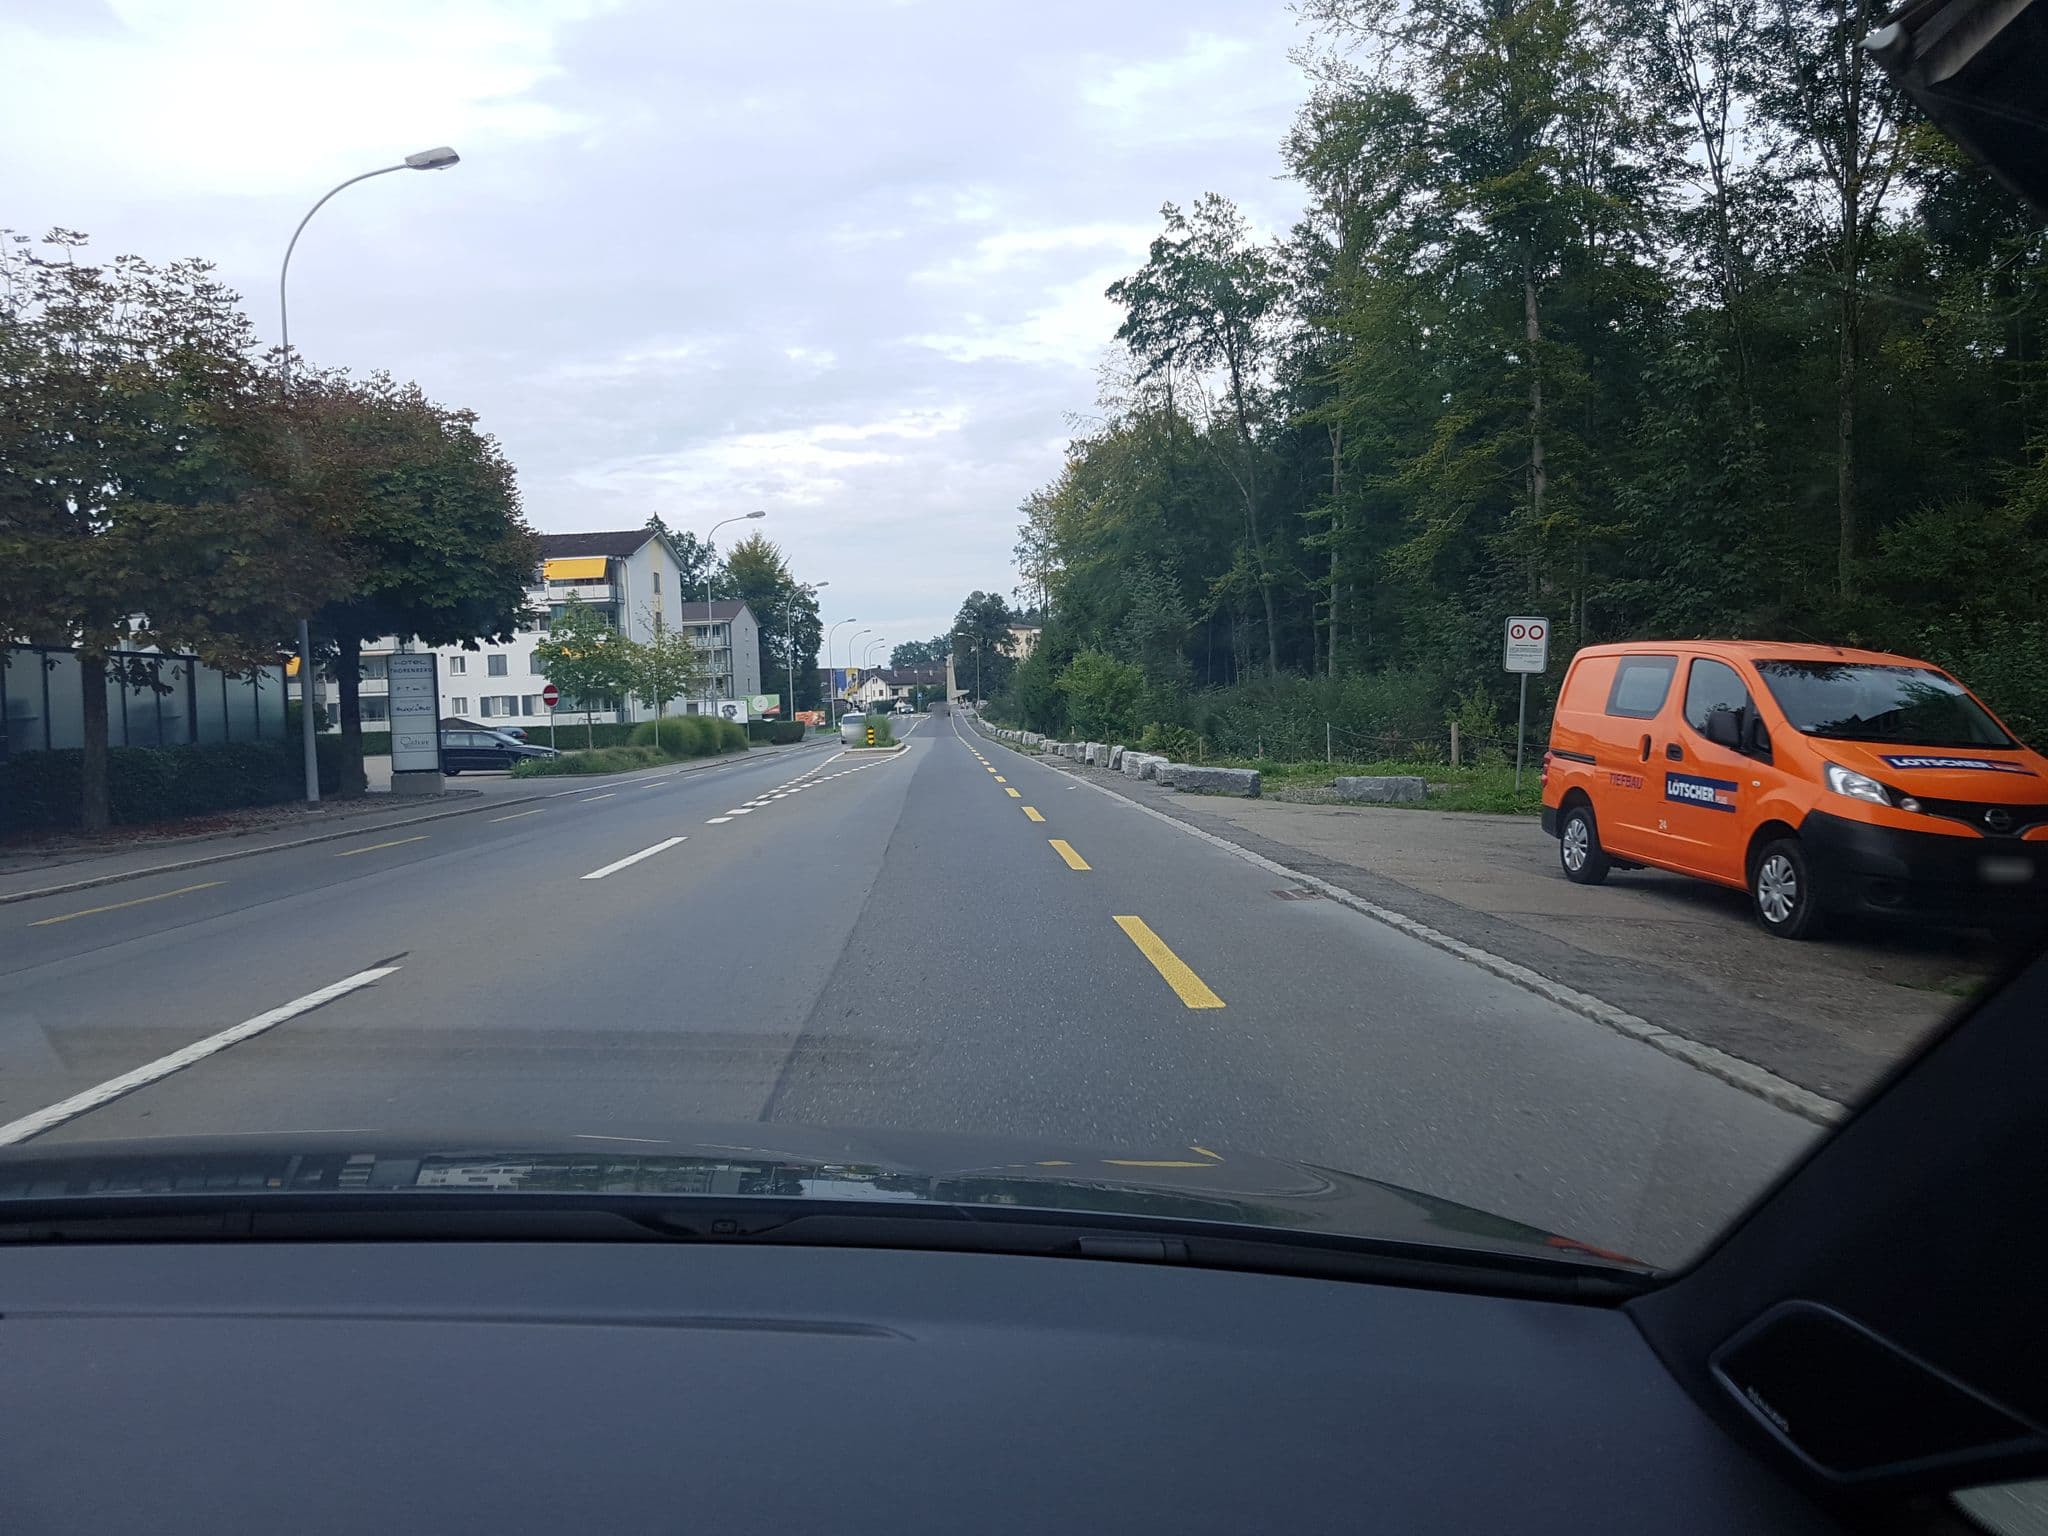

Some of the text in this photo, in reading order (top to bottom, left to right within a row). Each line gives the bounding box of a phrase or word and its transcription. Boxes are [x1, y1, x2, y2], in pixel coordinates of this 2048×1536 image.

[1609, 773, 1644, 790] TIEFBAU
[1667, 779, 1714, 803] LÖTSCHER
[1658, 819, 1668, 830] 24
